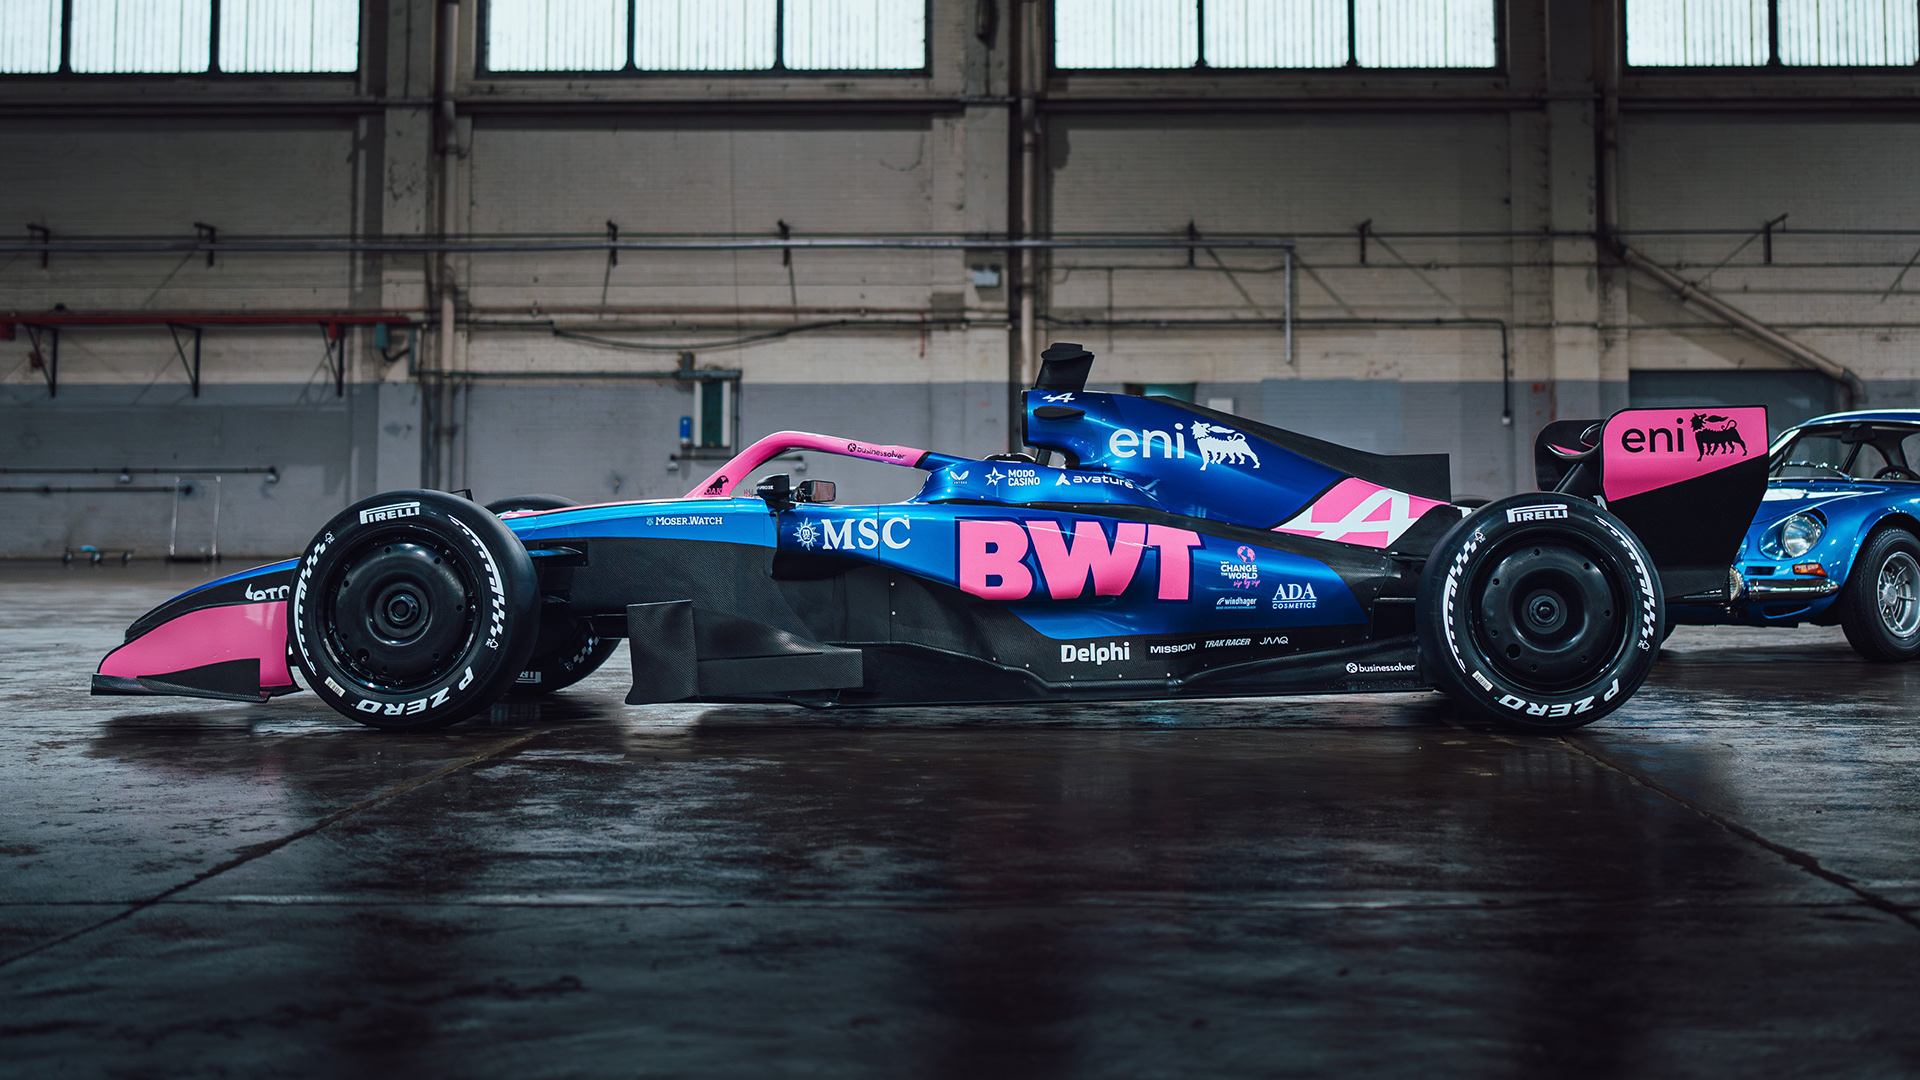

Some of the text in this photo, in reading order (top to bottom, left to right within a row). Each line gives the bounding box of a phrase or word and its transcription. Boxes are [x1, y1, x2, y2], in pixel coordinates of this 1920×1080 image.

[1109, 422, 1186, 459] eni
[1621, 418, 1684, 453] eni
[857, 445, 907, 459] businessolver
[1008, 469, 1035, 478] MODO
[1008, 477, 1040, 487] CASINO
[1073, 475, 1134, 489] avature
[360, 501, 420, 525] PIRELLI
[1506, 504, 1568, 524] PIRELLI
[655, 516, 723, 526] MOSER.WATCH
[821, 517, 911, 550] MSC
[959, 520, 1202, 600] BWT
[1220, 564, 1258, 572] CHANGE
[1228, 572, 1258, 580] WORLD
[1272, 583, 1318, 601] ADA
[1224, 597, 1257, 606] windhager
[1272, 602, 1317, 610] COSMETICS
[1150, 643, 1197, 654] MISSION
[1204, 638, 1252, 648] TRAK RACER
[1061, 641, 1130, 665] Delphi
[1358, 662, 1416, 673] businessolver
[355, 666, 475, 716] P ZERO
[1498, 678, 1620, 718] P ZERO
